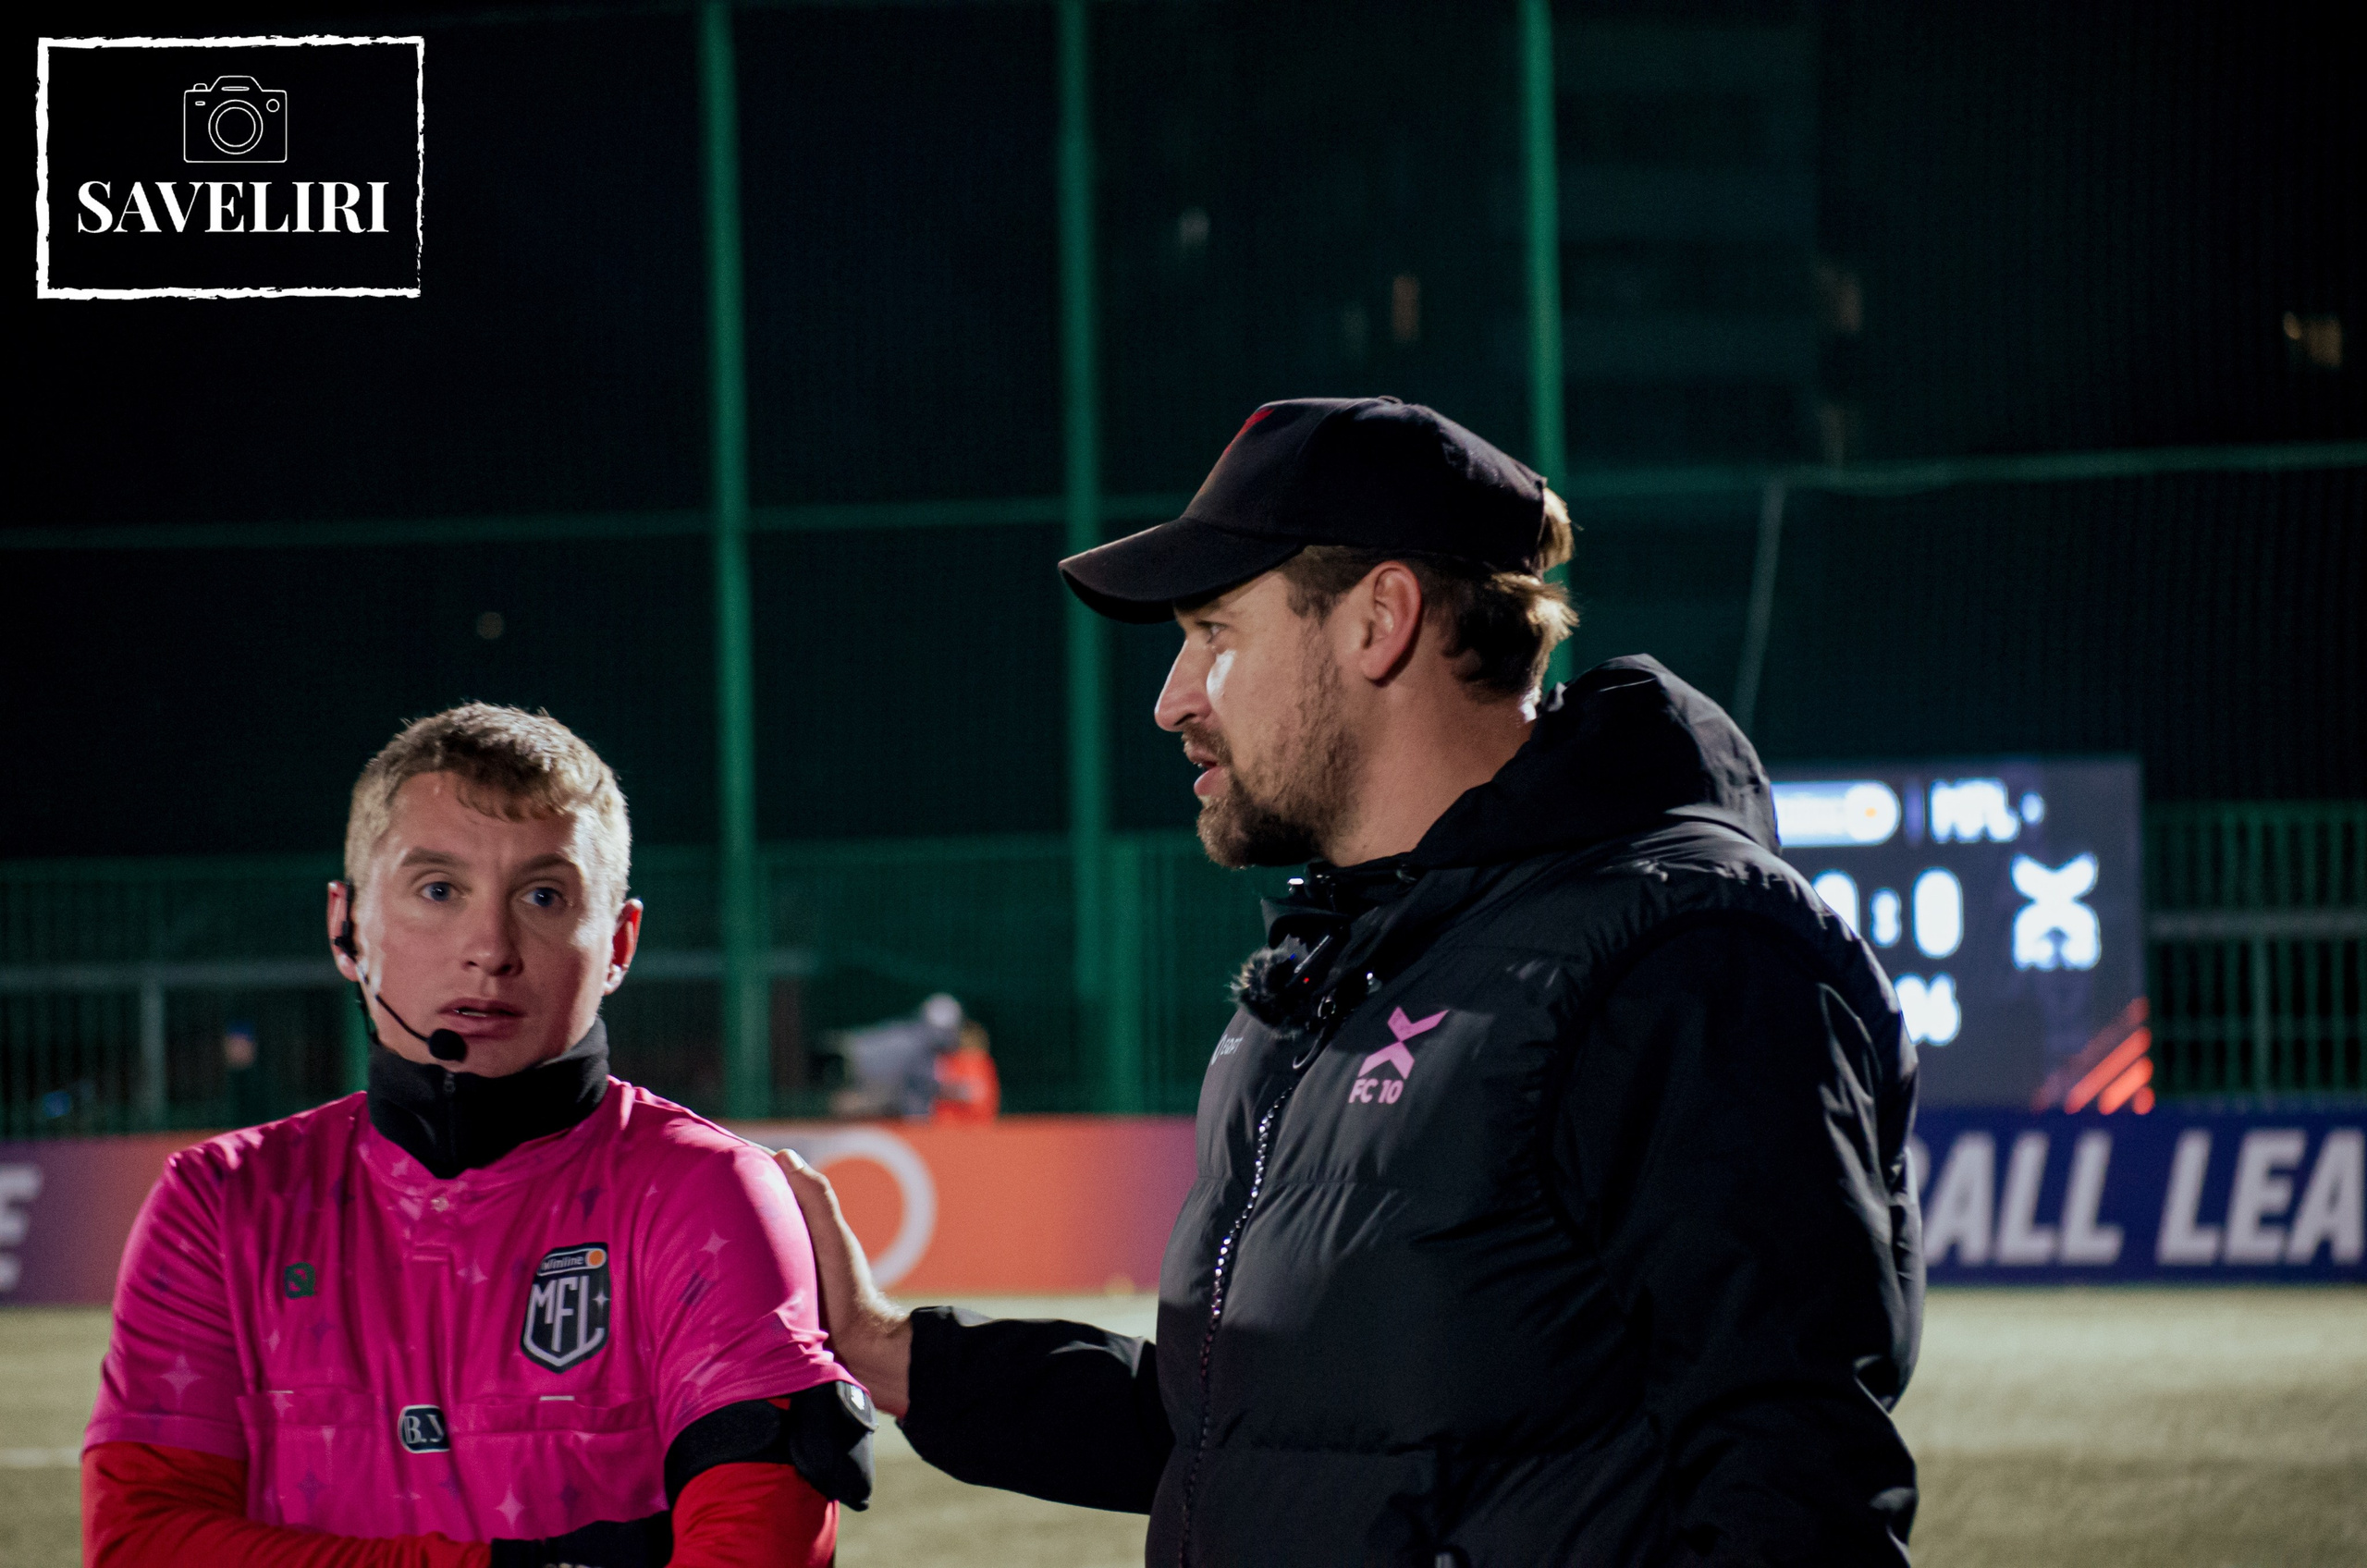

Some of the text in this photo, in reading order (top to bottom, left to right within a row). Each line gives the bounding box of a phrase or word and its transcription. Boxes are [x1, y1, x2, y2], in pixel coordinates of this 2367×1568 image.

[1348, 1078, 1404, 1105] FC 10
[523, 1275, 605, 1366] MFL
